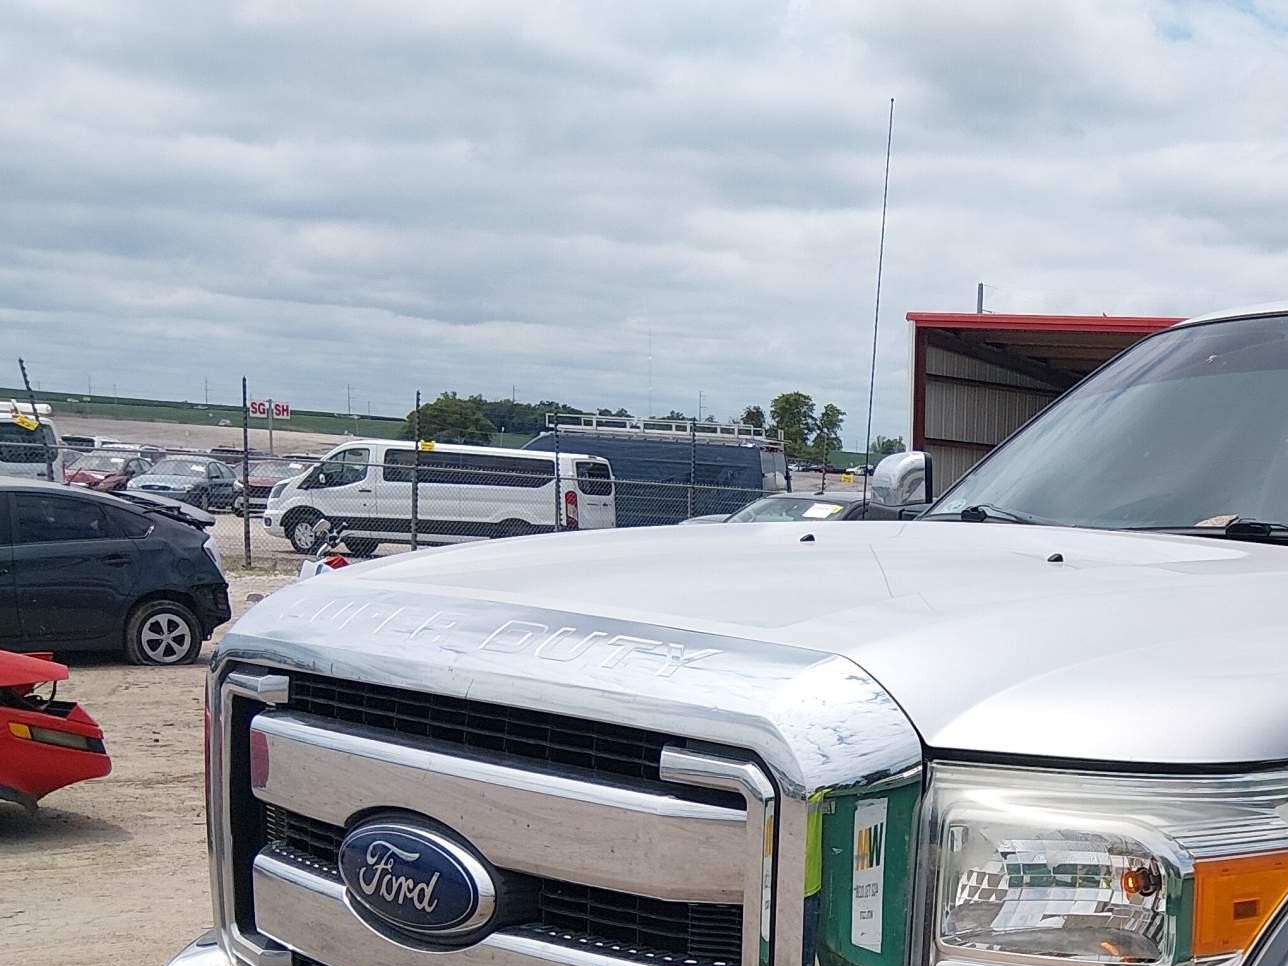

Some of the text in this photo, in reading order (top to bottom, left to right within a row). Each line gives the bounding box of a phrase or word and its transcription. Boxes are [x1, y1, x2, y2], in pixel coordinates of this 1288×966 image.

[251, 402, 266, 414] SG
[275, 404, 289, 417] SH
[479, 618, 724, 678] DUTY
[359, 840, 441, 913] Ford
